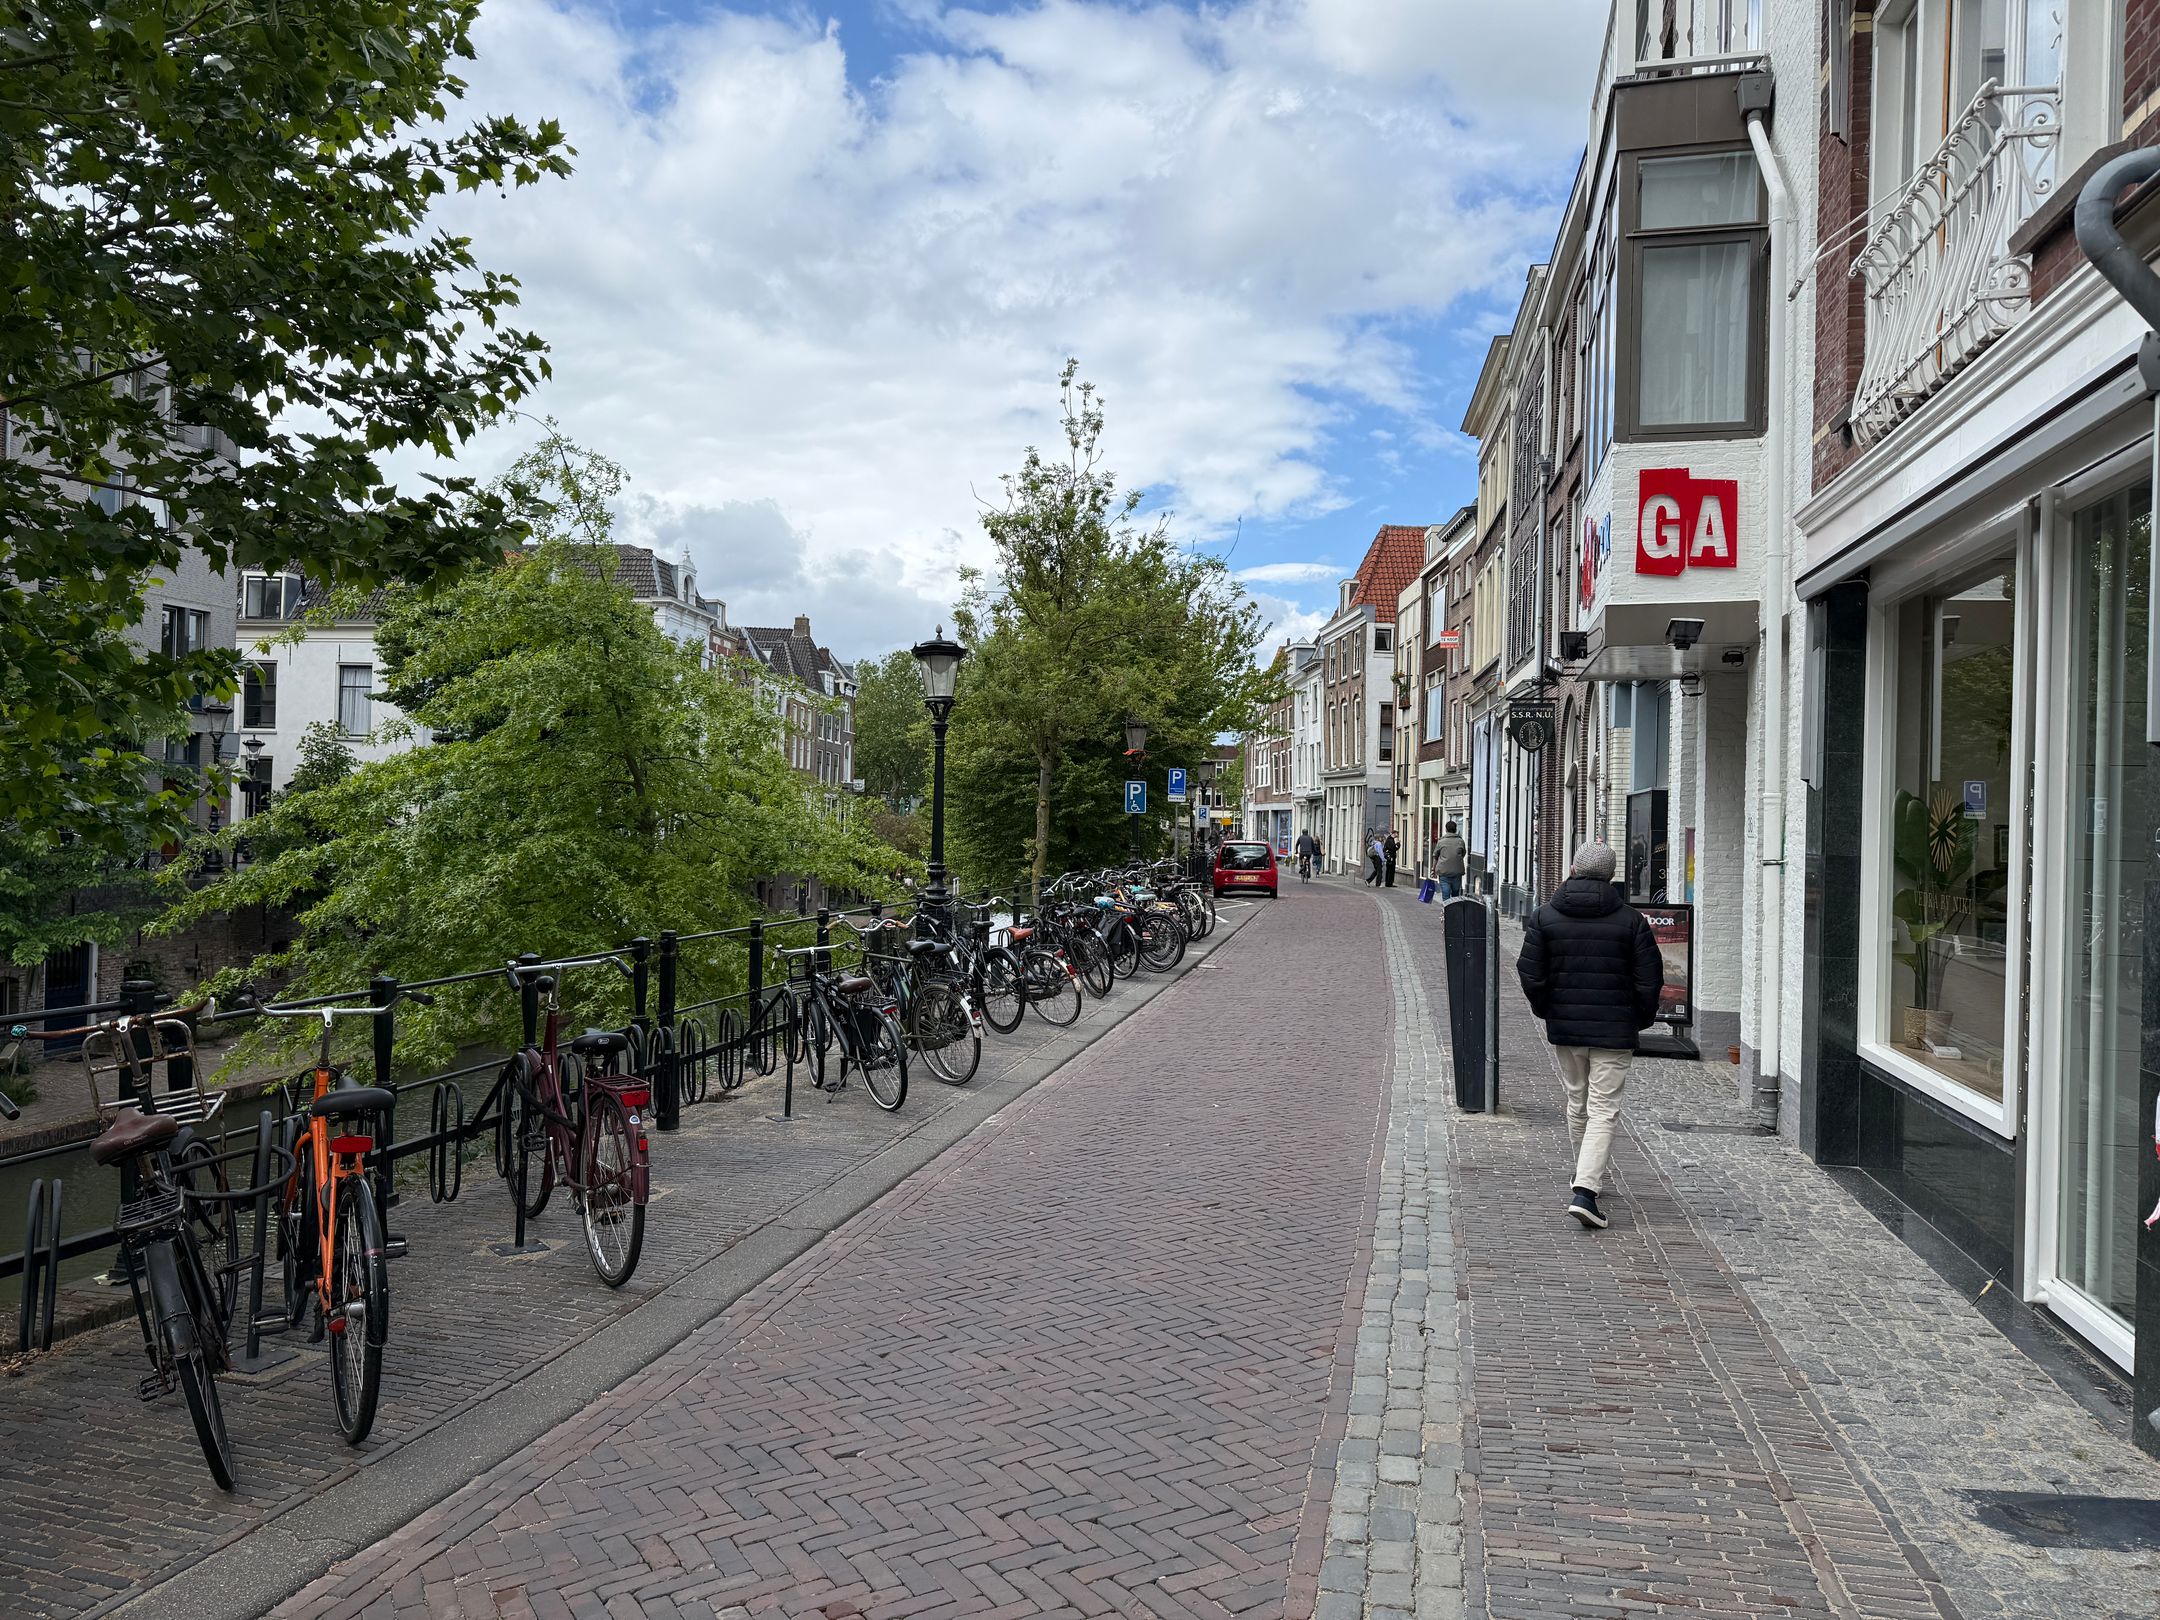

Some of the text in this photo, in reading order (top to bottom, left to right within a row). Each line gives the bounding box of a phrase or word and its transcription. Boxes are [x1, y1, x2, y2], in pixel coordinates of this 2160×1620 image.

[1641, 494, 1728, 558] GA
[1511, 711, 1553, 719] S.S.R. N.U.
[1173, 771, 1182, 784] P
[1130, 784, 1142, 800] P
